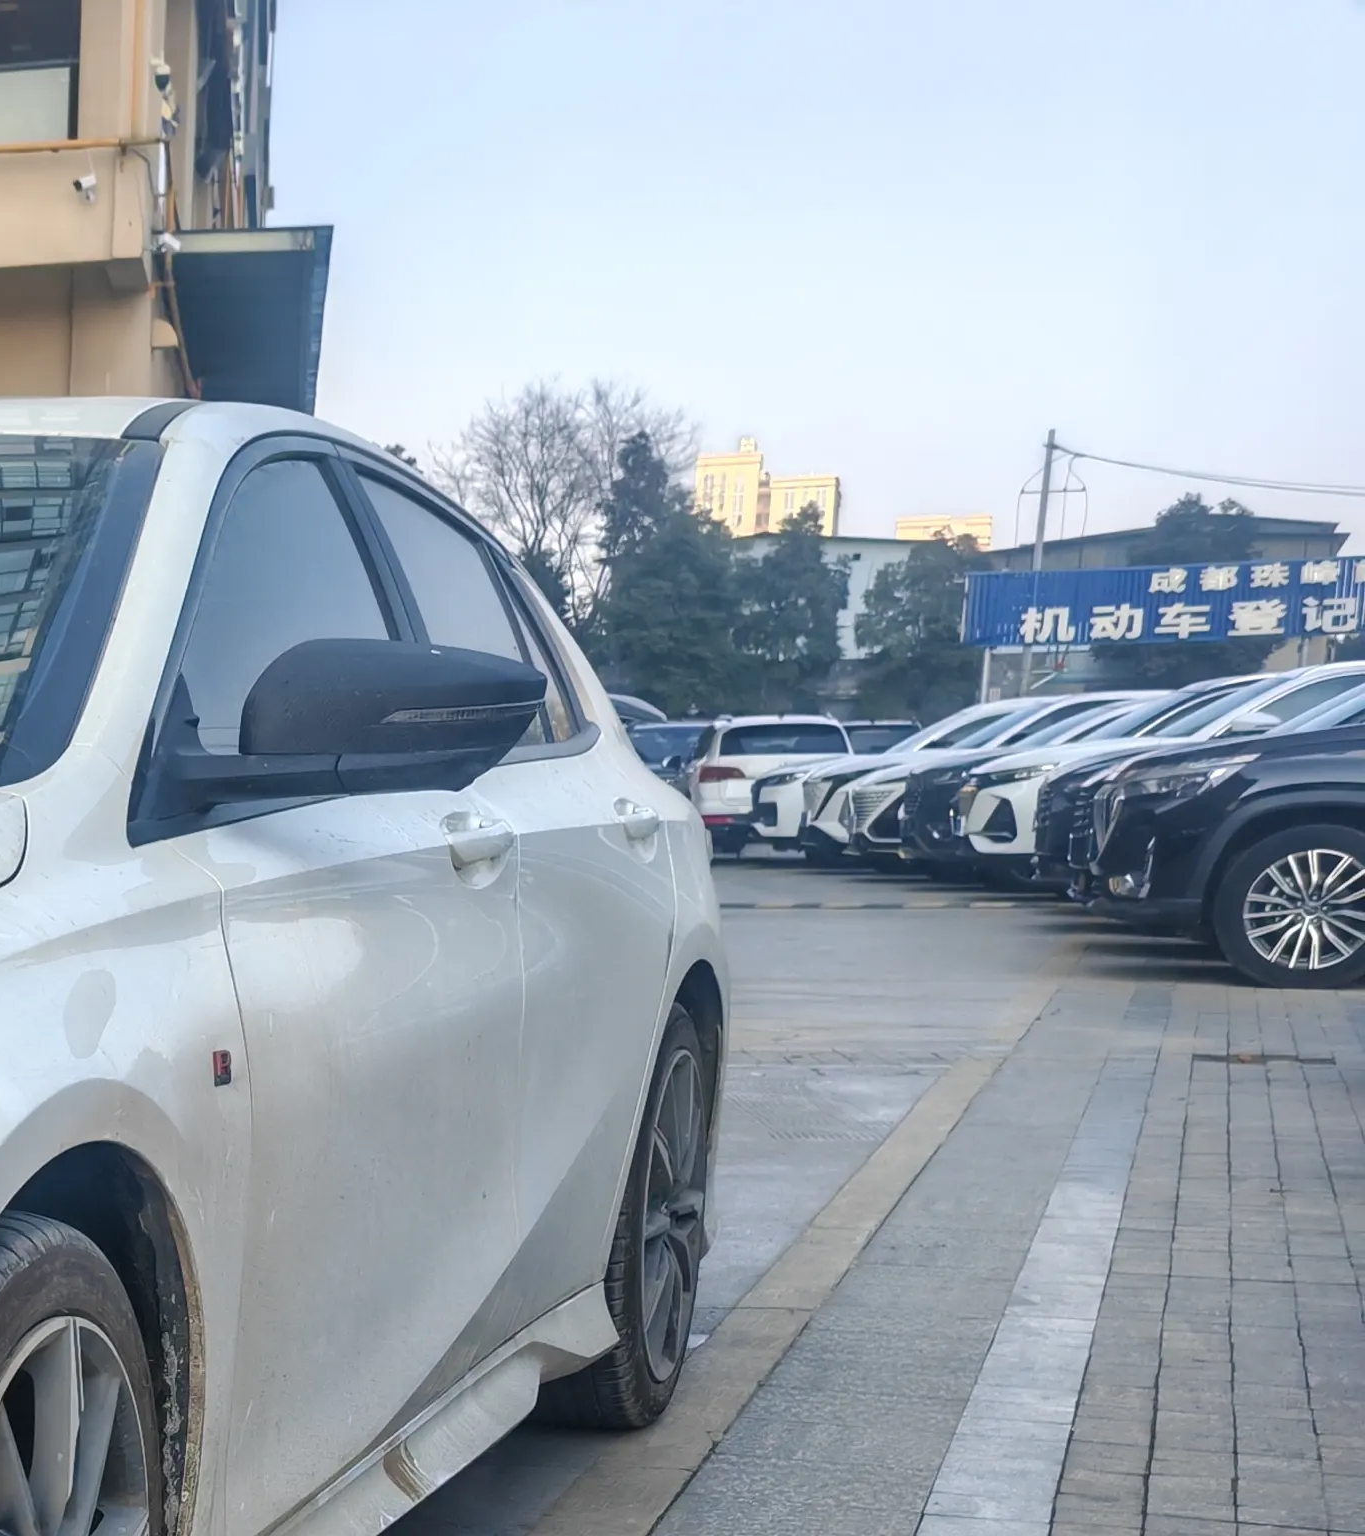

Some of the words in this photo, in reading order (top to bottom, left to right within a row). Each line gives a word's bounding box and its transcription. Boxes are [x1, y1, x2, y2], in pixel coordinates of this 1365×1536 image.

[1148, 559, 1365, 594] 成都珠峰
[1019, 596, 1358, 644] 机动车登记
